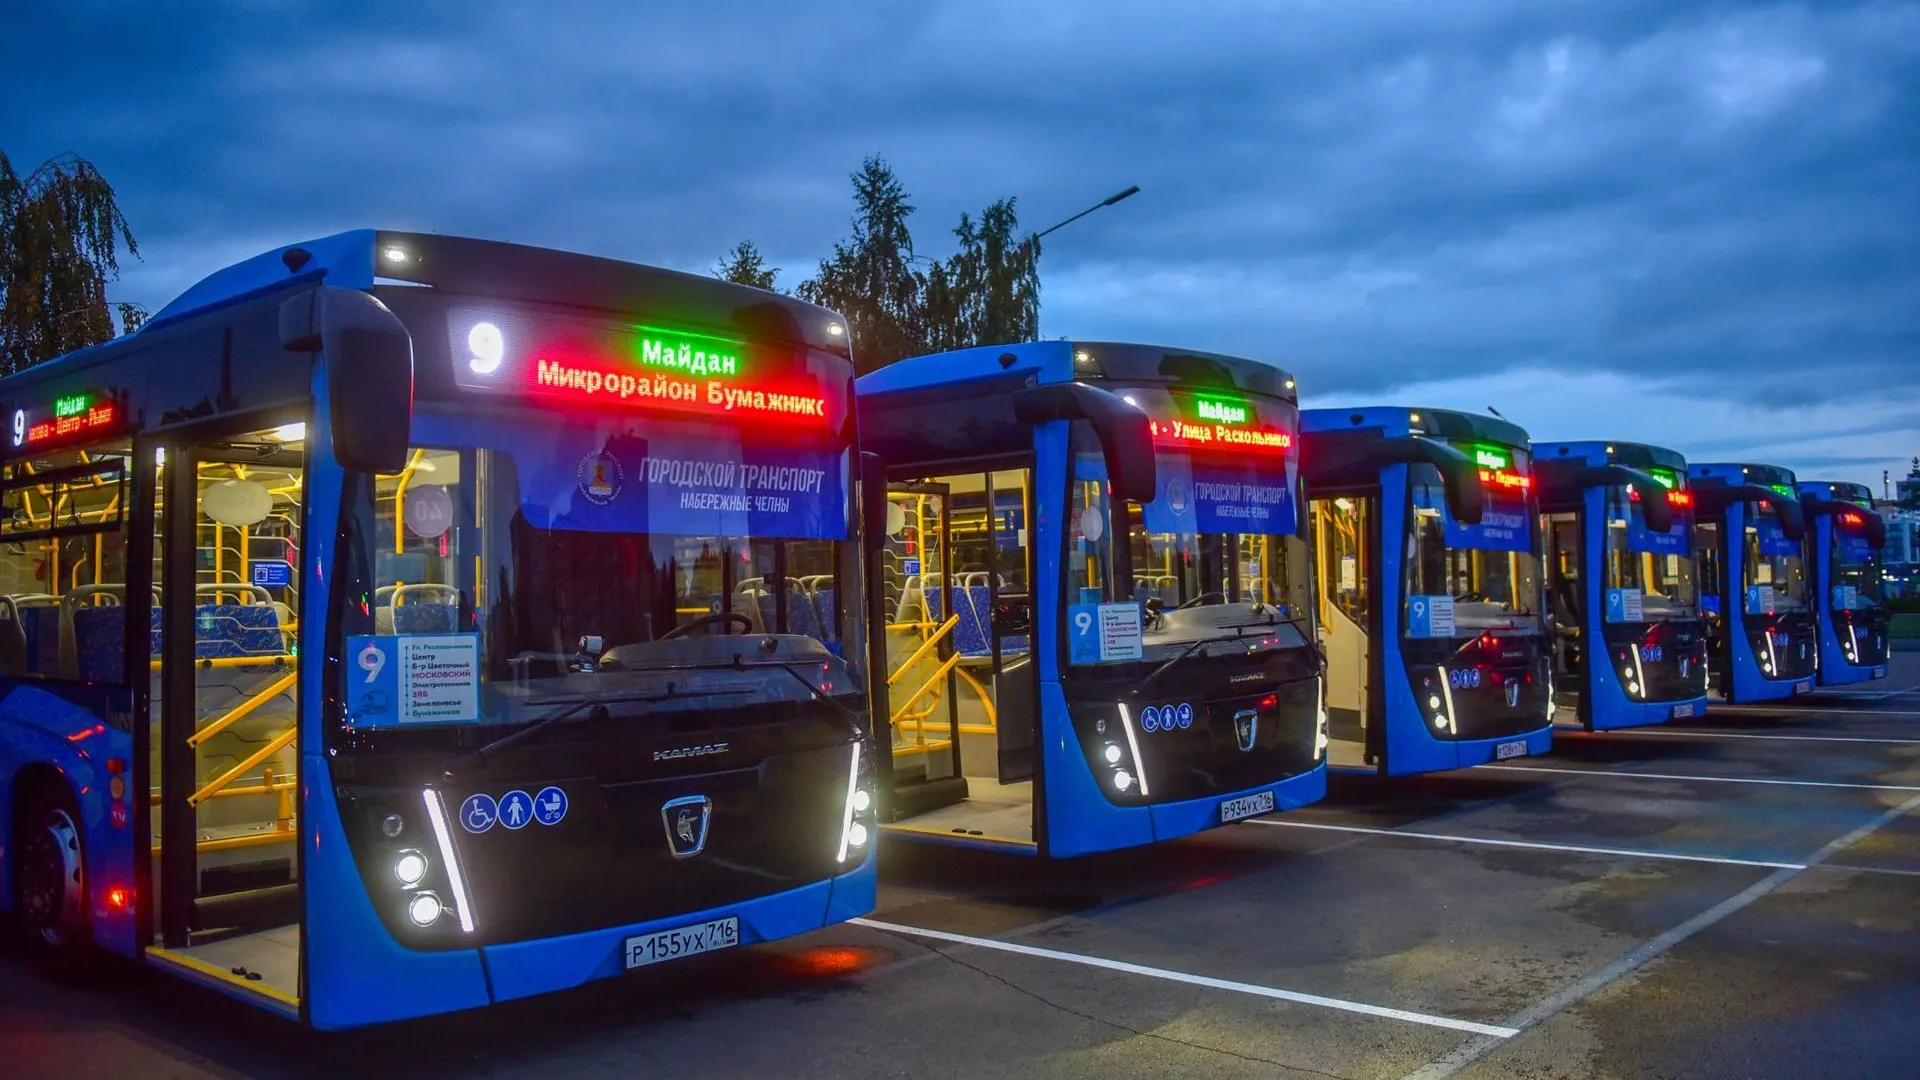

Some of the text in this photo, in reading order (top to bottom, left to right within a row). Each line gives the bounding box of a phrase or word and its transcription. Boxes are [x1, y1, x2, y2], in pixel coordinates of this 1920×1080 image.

[468, 322, 504, 374] 9
[641, 338, 737, 376] Майдан
[537, 359, 698, 402] Микрорайон
[1198, 400, 1246, 424] Майдан
[14, 410, 24, 445] 9
[1172, 421, 1212, 442] Улица
[639, 456, 825, 494] ГОРОДСКОЙ ТРАНСПОРТ
[680, 492, 790, 514] НАБЕРЕЖНЫЕ ЧЕЛНЫ
[1195, 482, 1287, 504] ГОРОДСКОЙ ТРАНСПОРТ
[1413, 602, 1425, 618] 9
[1610, 594, 1619, 607] 9
[1075, 612, 1092, 636] 9
[358, 646, 386, 683] 9
[412, 670, 471, 679] МОСКОВСКИЙ
[428, 662, 470, 670] Цветочный
[708, 920, 734, 941] 716
